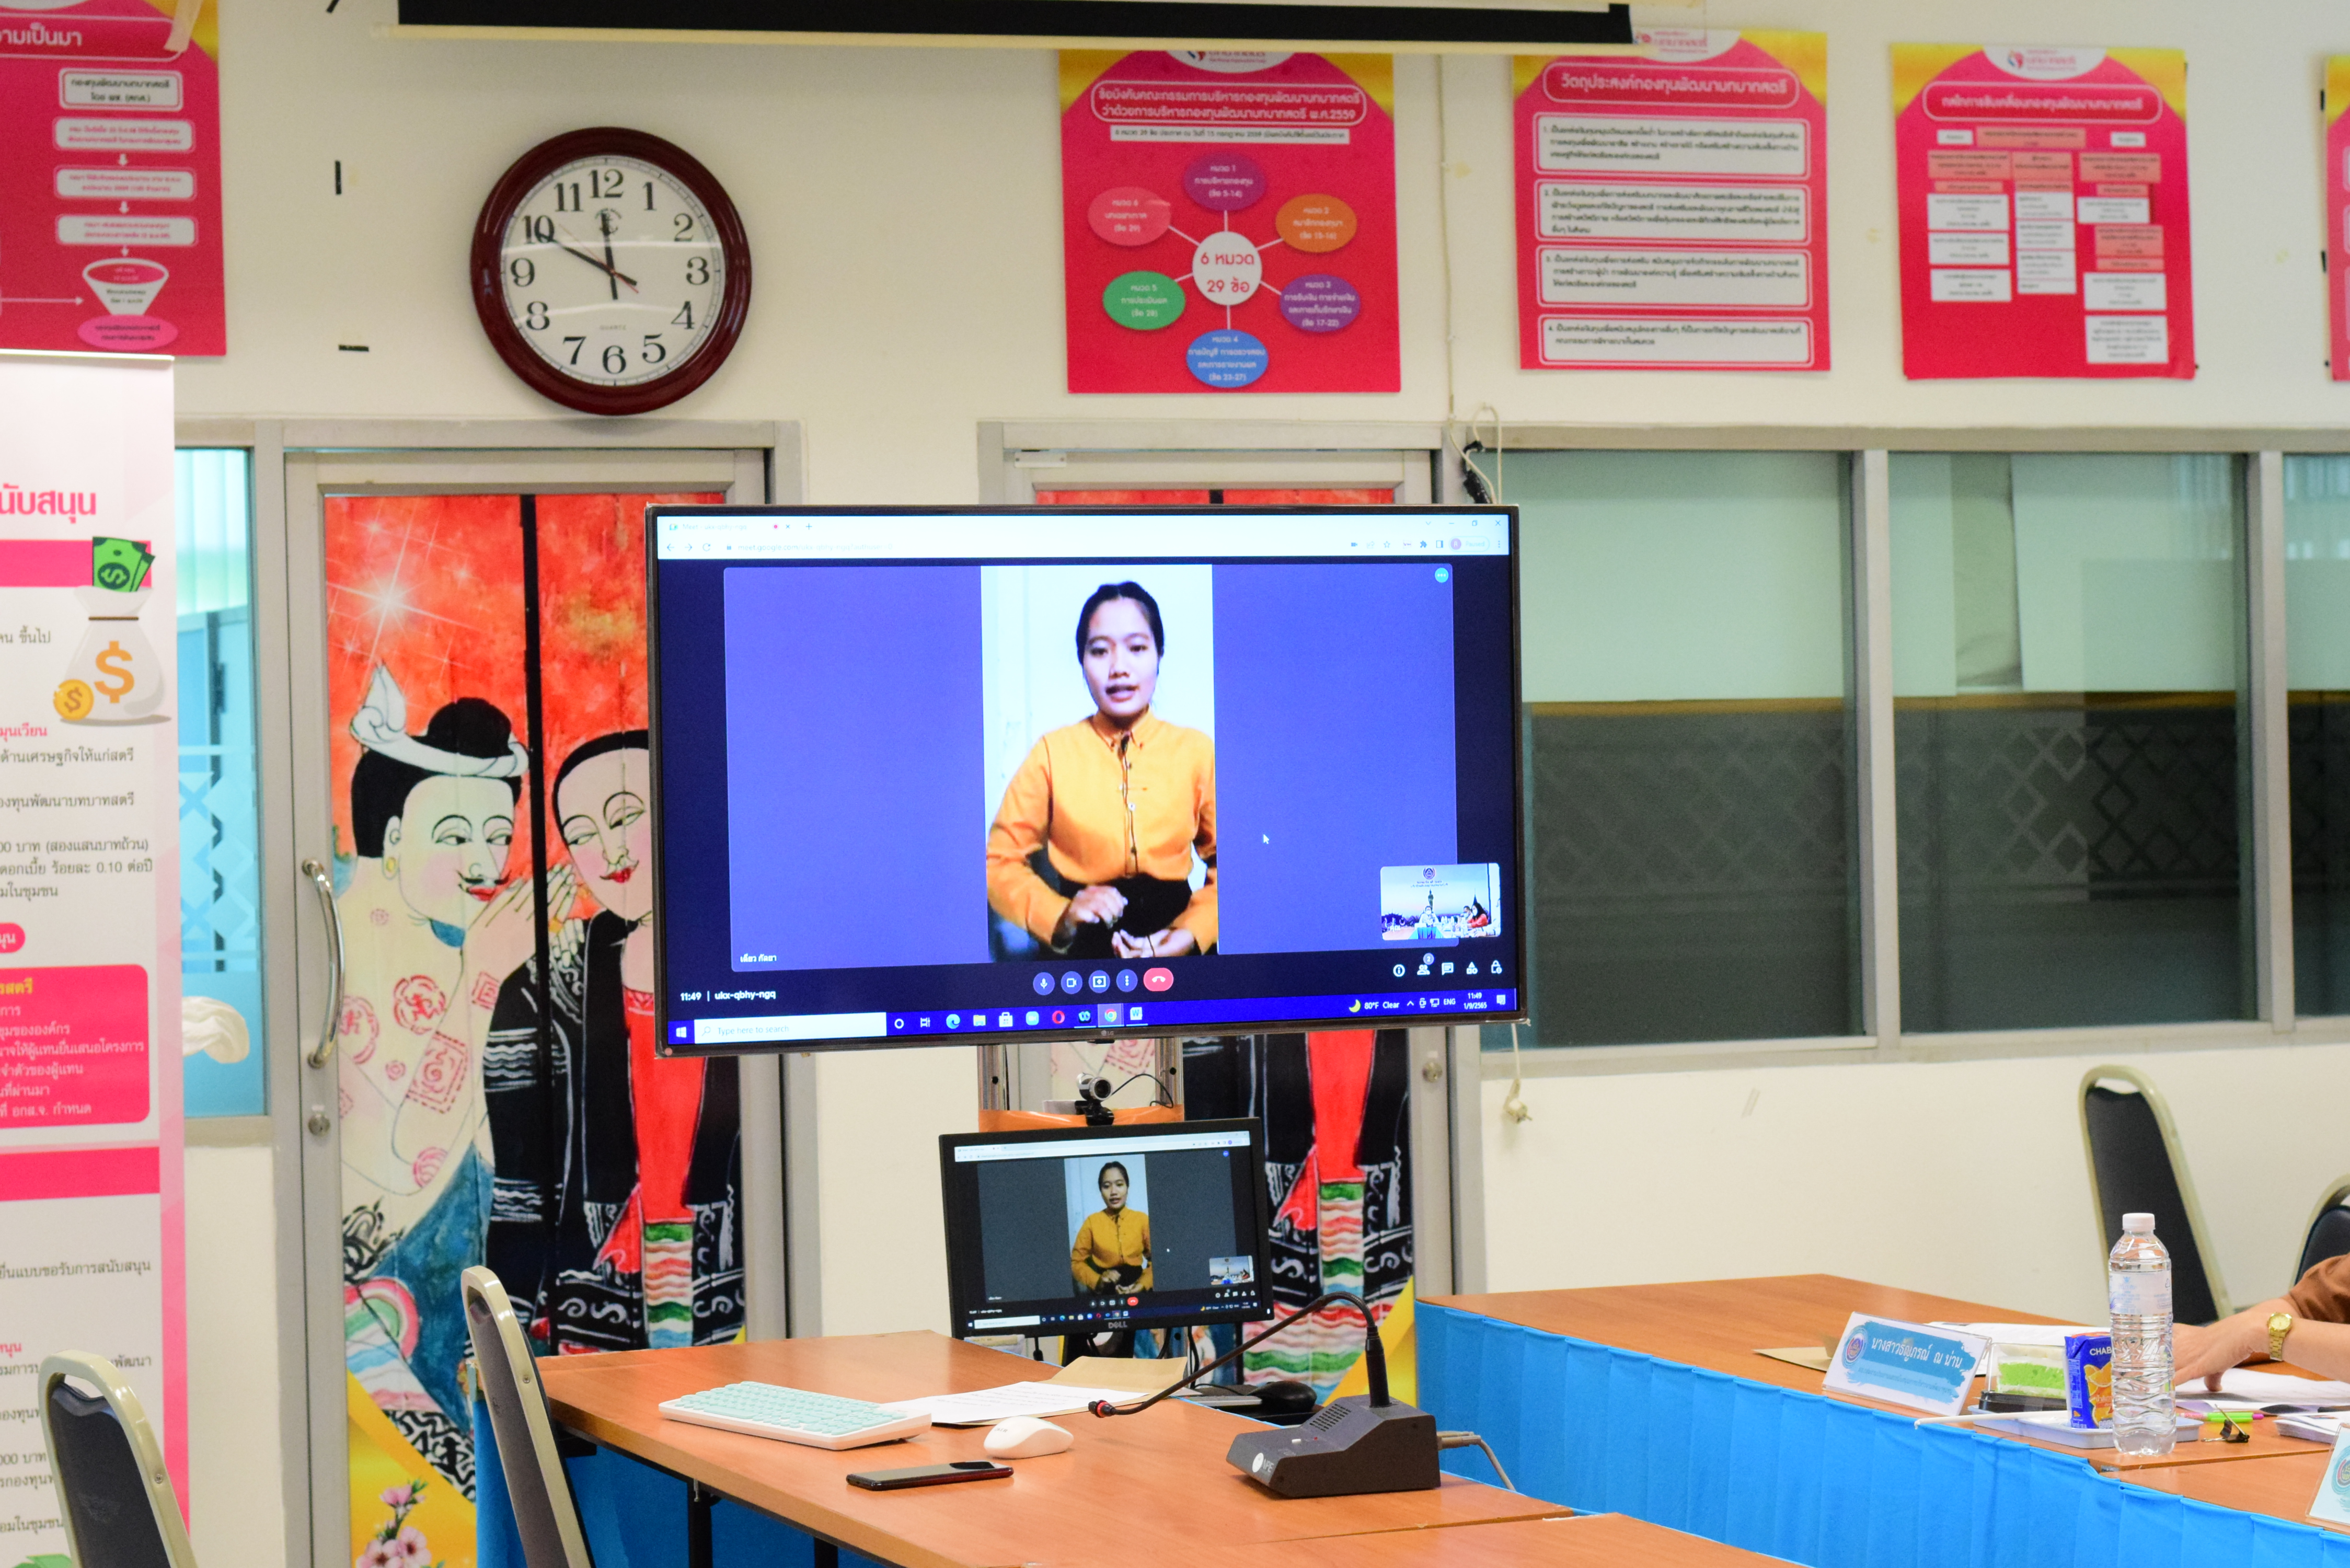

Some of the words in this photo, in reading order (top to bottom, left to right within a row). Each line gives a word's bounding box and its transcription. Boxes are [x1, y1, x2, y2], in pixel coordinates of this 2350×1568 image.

[554, 182, 584, 212] 11
[589, 169, 624, 199] 12
[643, 181, 657, 211] 1
[522, 215, 555, 244] 10
[674, 213, 694, 241] 2
[511, 257, 536, 287] 9
[686, 257, 710, 285] 3
[1201, 252, 1209, 265] 6
[1215, 253, 1254, 265] หมวด
[1207, 279, 1225, 293] 29
[1230, 276, 1250, 293] ข้อ
[526, 301, 550, 330] 8
[672, 301, 695, 330] 4
[563, 336, 586, 365] 7
[602, 345, 626, 374] 6
[642, 334, 666, 363] 5
[19, 625, 51, 644] ขึ้นไป
[17, 842, 40, 852] บาท
[46, 837, 148, 854] (สองแสนบาทถ้วน)
[52, 860, 90, 874] ร้อยละ
[97, 862, 122, 873] 0.10
[128, 858, 153, 872] ต่อปี
[680, 992, 701, 1001] 11:49
[715, 990, 776, 1001] ukx-qbhy-ngq
[718, 1027, 735, 1036] Type
[765, 1025, 790, 1033] search
[0, 1062, 83, 1080] จำตัวของผู้แทน
[1108, 1321, 1128, 1329] DELL
[1933, 1352, 1943, 1364] ณ
[1944, 1350, 1963, 1369] น่าน
[0, 1409, 39, 1424] องทุน
